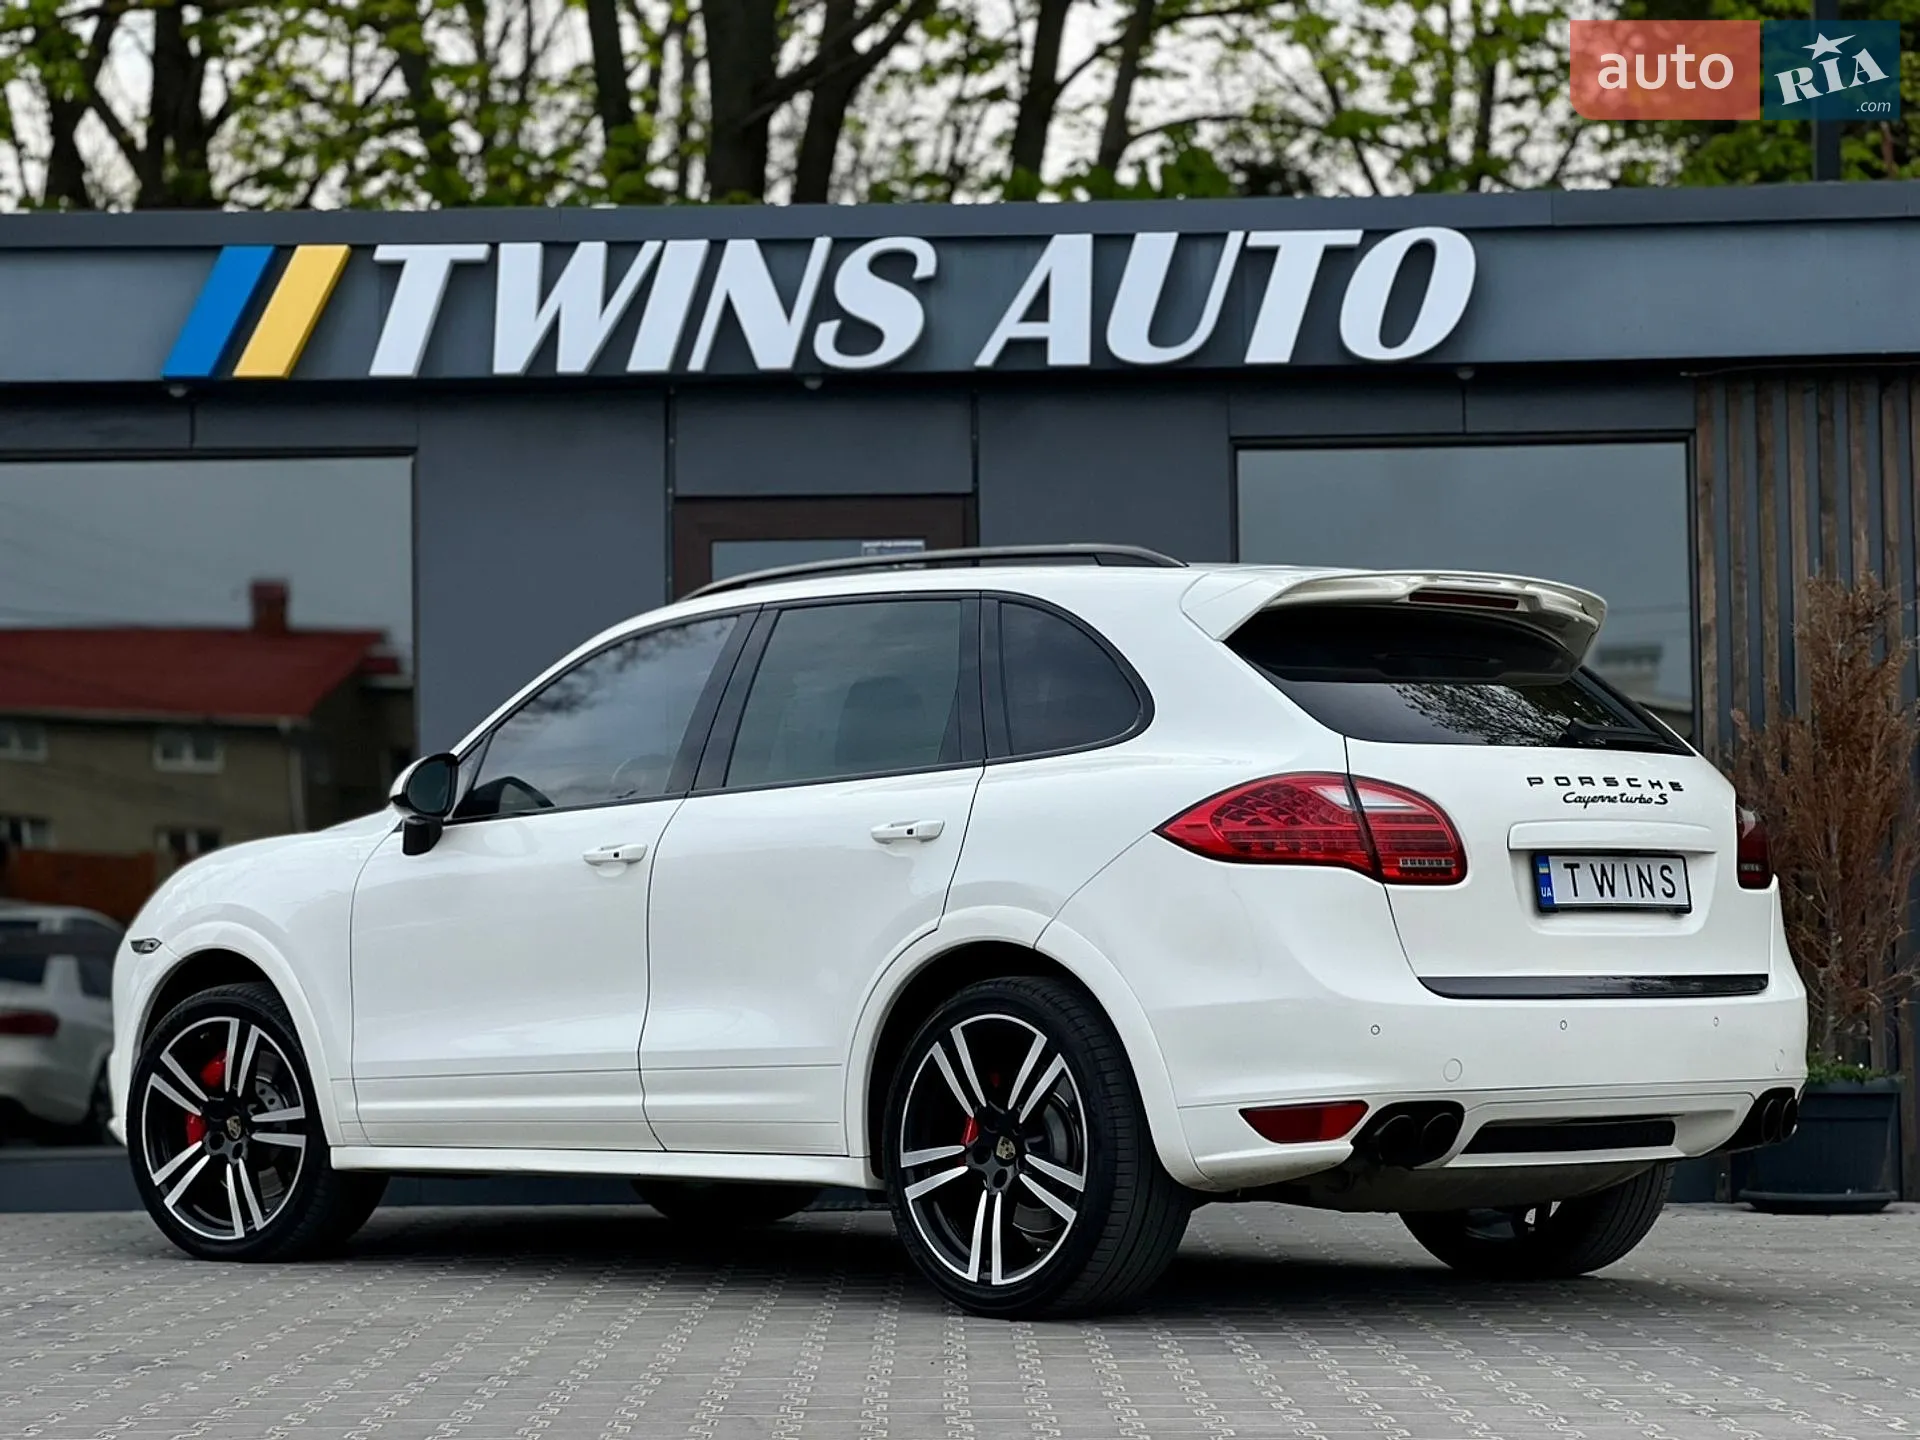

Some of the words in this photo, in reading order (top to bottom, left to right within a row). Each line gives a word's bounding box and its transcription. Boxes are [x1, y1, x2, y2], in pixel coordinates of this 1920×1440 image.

[368, 235, 938, 379] TWINS
[974, 226, 1477, 368] AUTO
[1526, 776, 1684, 792] PORSCHE
[1562, 792, 1618, 809] Cayenne
[1654, 793, 1669, 805] S
[1562, 862, 1677, 899] TWINS
[1541, 887, 1553, 898] UA
